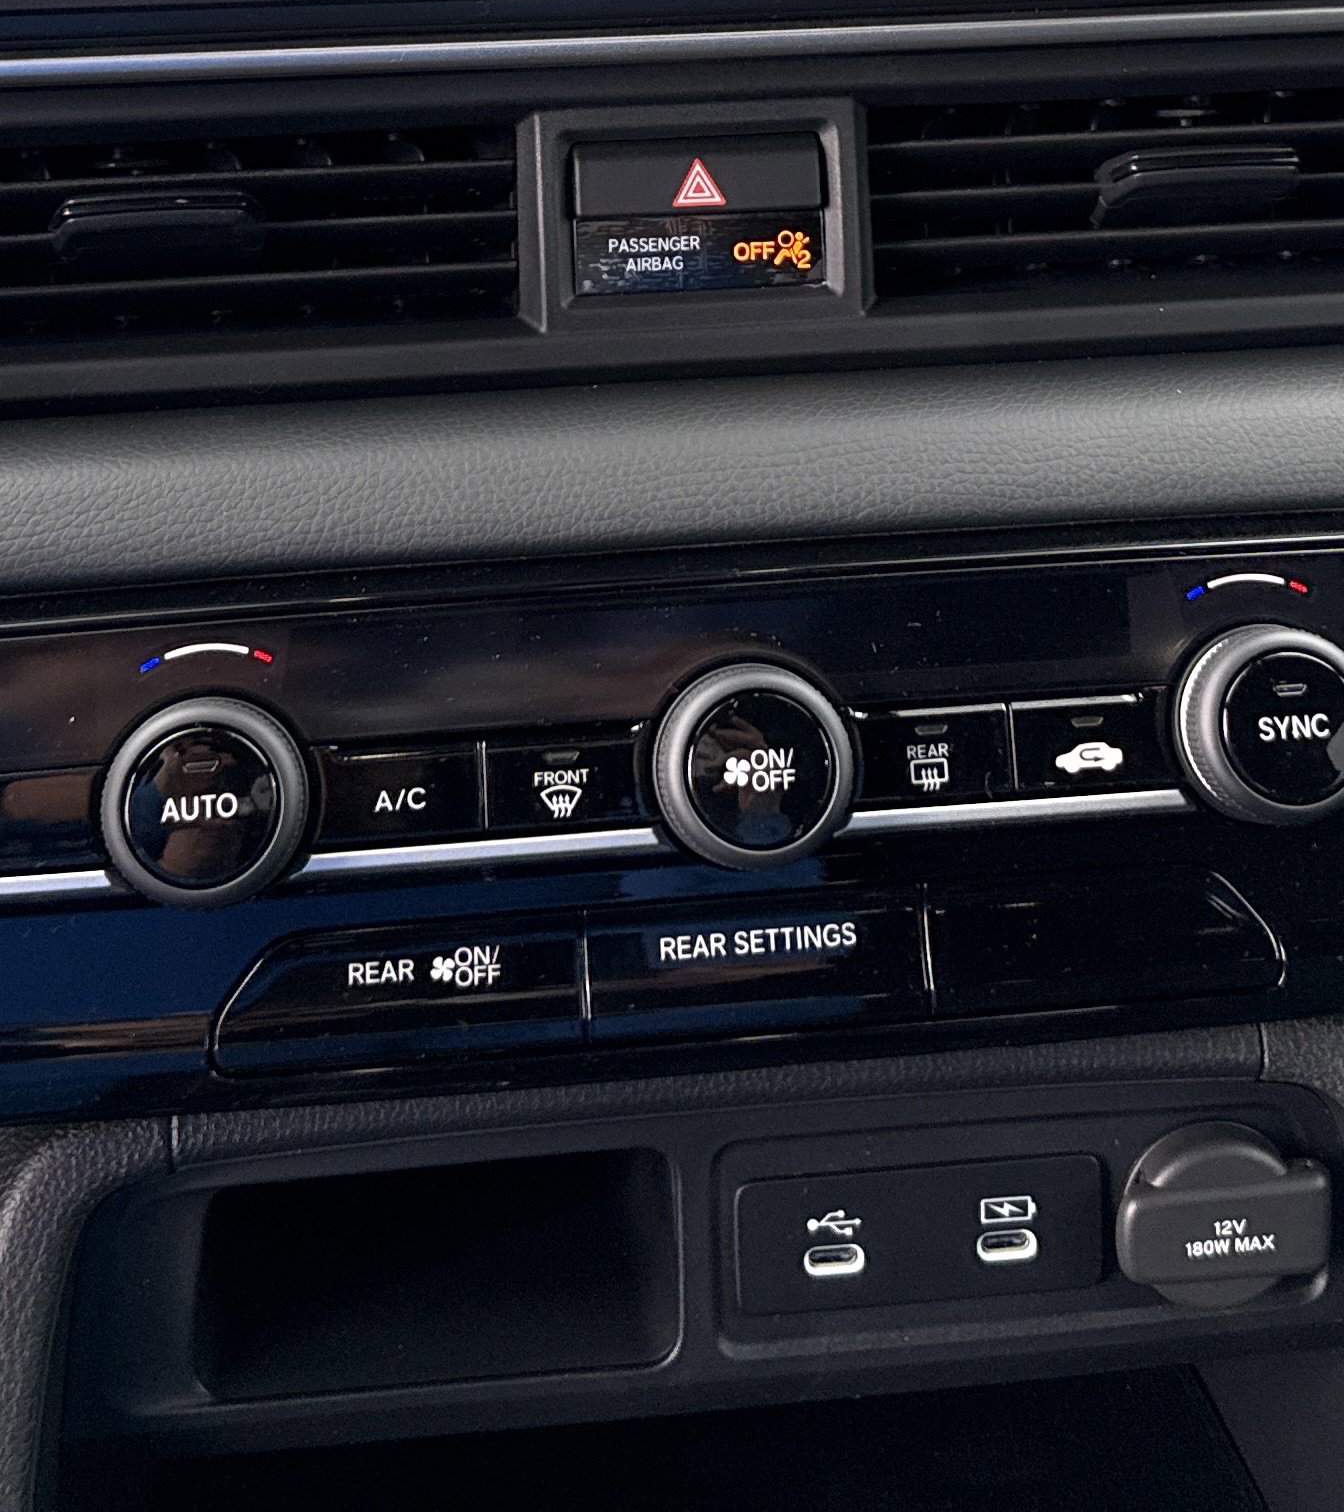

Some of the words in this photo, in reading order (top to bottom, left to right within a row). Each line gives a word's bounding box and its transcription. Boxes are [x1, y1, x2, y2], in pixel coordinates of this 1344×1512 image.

[608, 235, 701, 254] PASSENGER
[733, 240, 775, 262] OFF
[626, 255, 684, 273] AIRBAG
[1258, 713, 1332, 742] SYNC
[750, 748, 794, 770] ON/
[907, 743, 948, 759] REAR
[533, 768, 590, 787] FRONT
[752, 768, 796, 792] OFF
[160, 792, 238, 824] AUTO
[374, 787, 427, 813] A/C
[660, 932, 727, 961] REAR
[734, 922, 857, 955] SETTINGS
[454, 945, 500, 966] ON/
[348, 958, 415, 986] REAR
[456, 963, 501, 987] OFF
[1214, 1218, 1247, 1236] 12V
[1184, 1238, 1231, 1257] 180W
[1235, 1234, 1276, 1253] MAX
